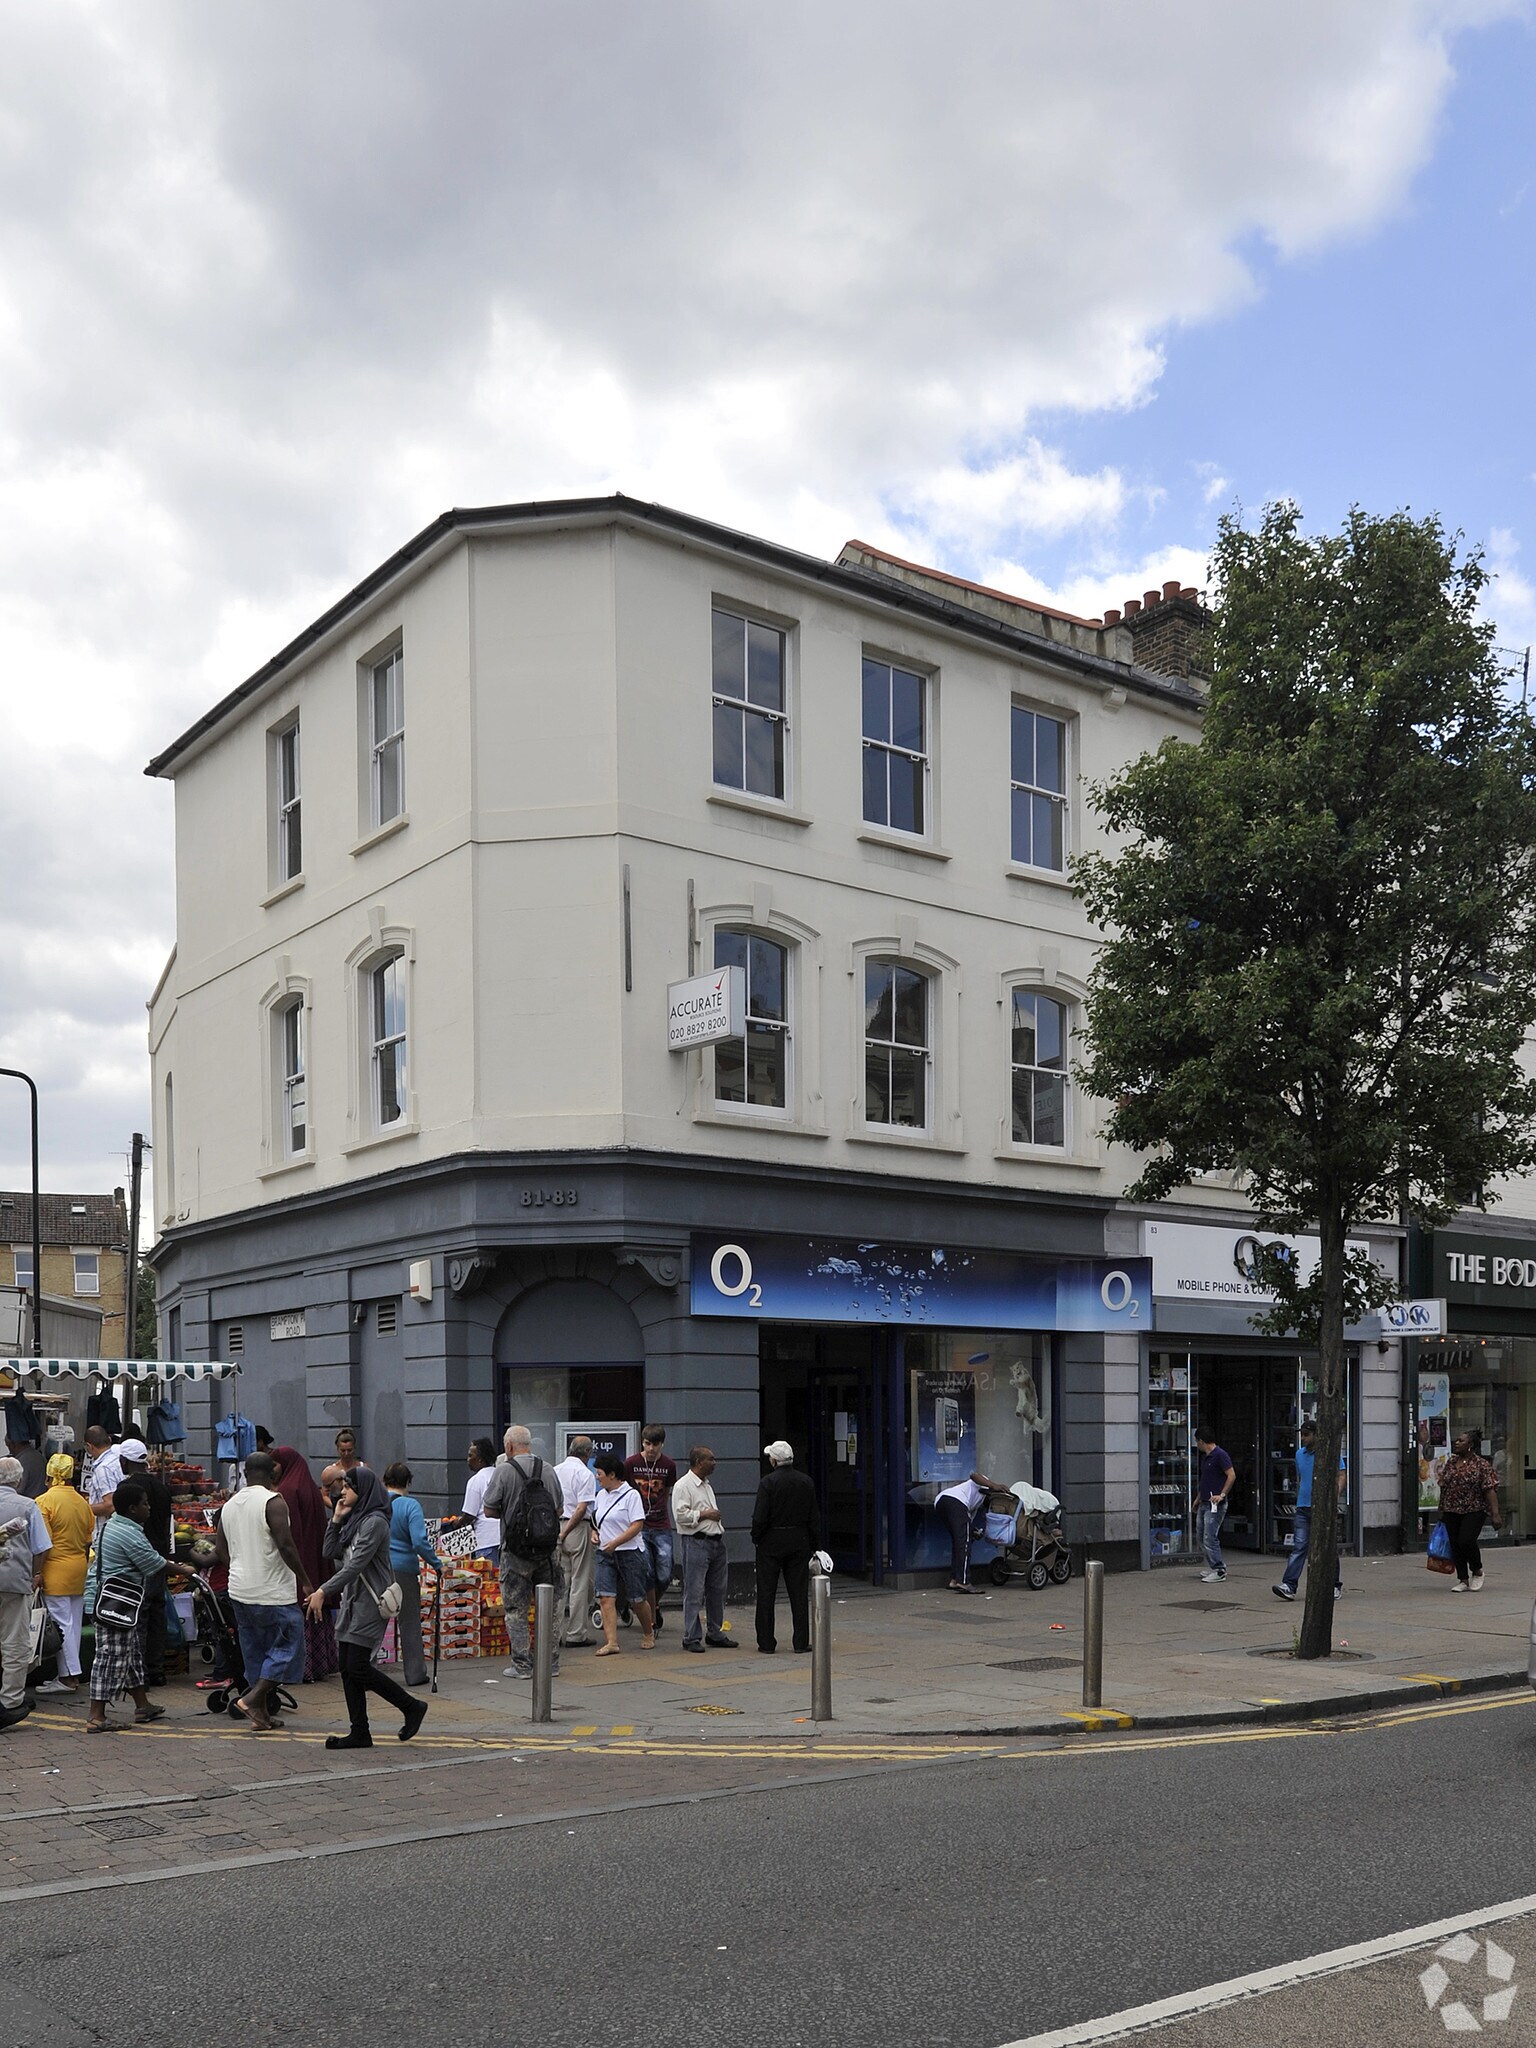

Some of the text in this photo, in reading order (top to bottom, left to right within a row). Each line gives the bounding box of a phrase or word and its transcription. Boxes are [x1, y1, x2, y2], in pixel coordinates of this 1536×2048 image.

[670, 992, 722, 1020] ACCURATE
[670, 1016, 726, 1040] 020 8829 8200
[520, 1188, 577, 1206] 81-83
[1151, 1226, 1157, 1234] 83
[711, 1244, 762, 1307] O2
[1446, 1252, 1536, 1287] THE BOD
[1101, 1271, 1139, 1317] O2
[1177, 1279, 1210, 1291] MOBILE
[1212, 1282, 1241, 1293] PHONE
[1243, 1283, 1249, 1293] &
[271, 1313, 299, 1327] BRAMPTON
[286, 1325, 300, 1336] ROAD
[600, 1442, 614, 1452] up
[655, 1467, 669, 1475] RISE
